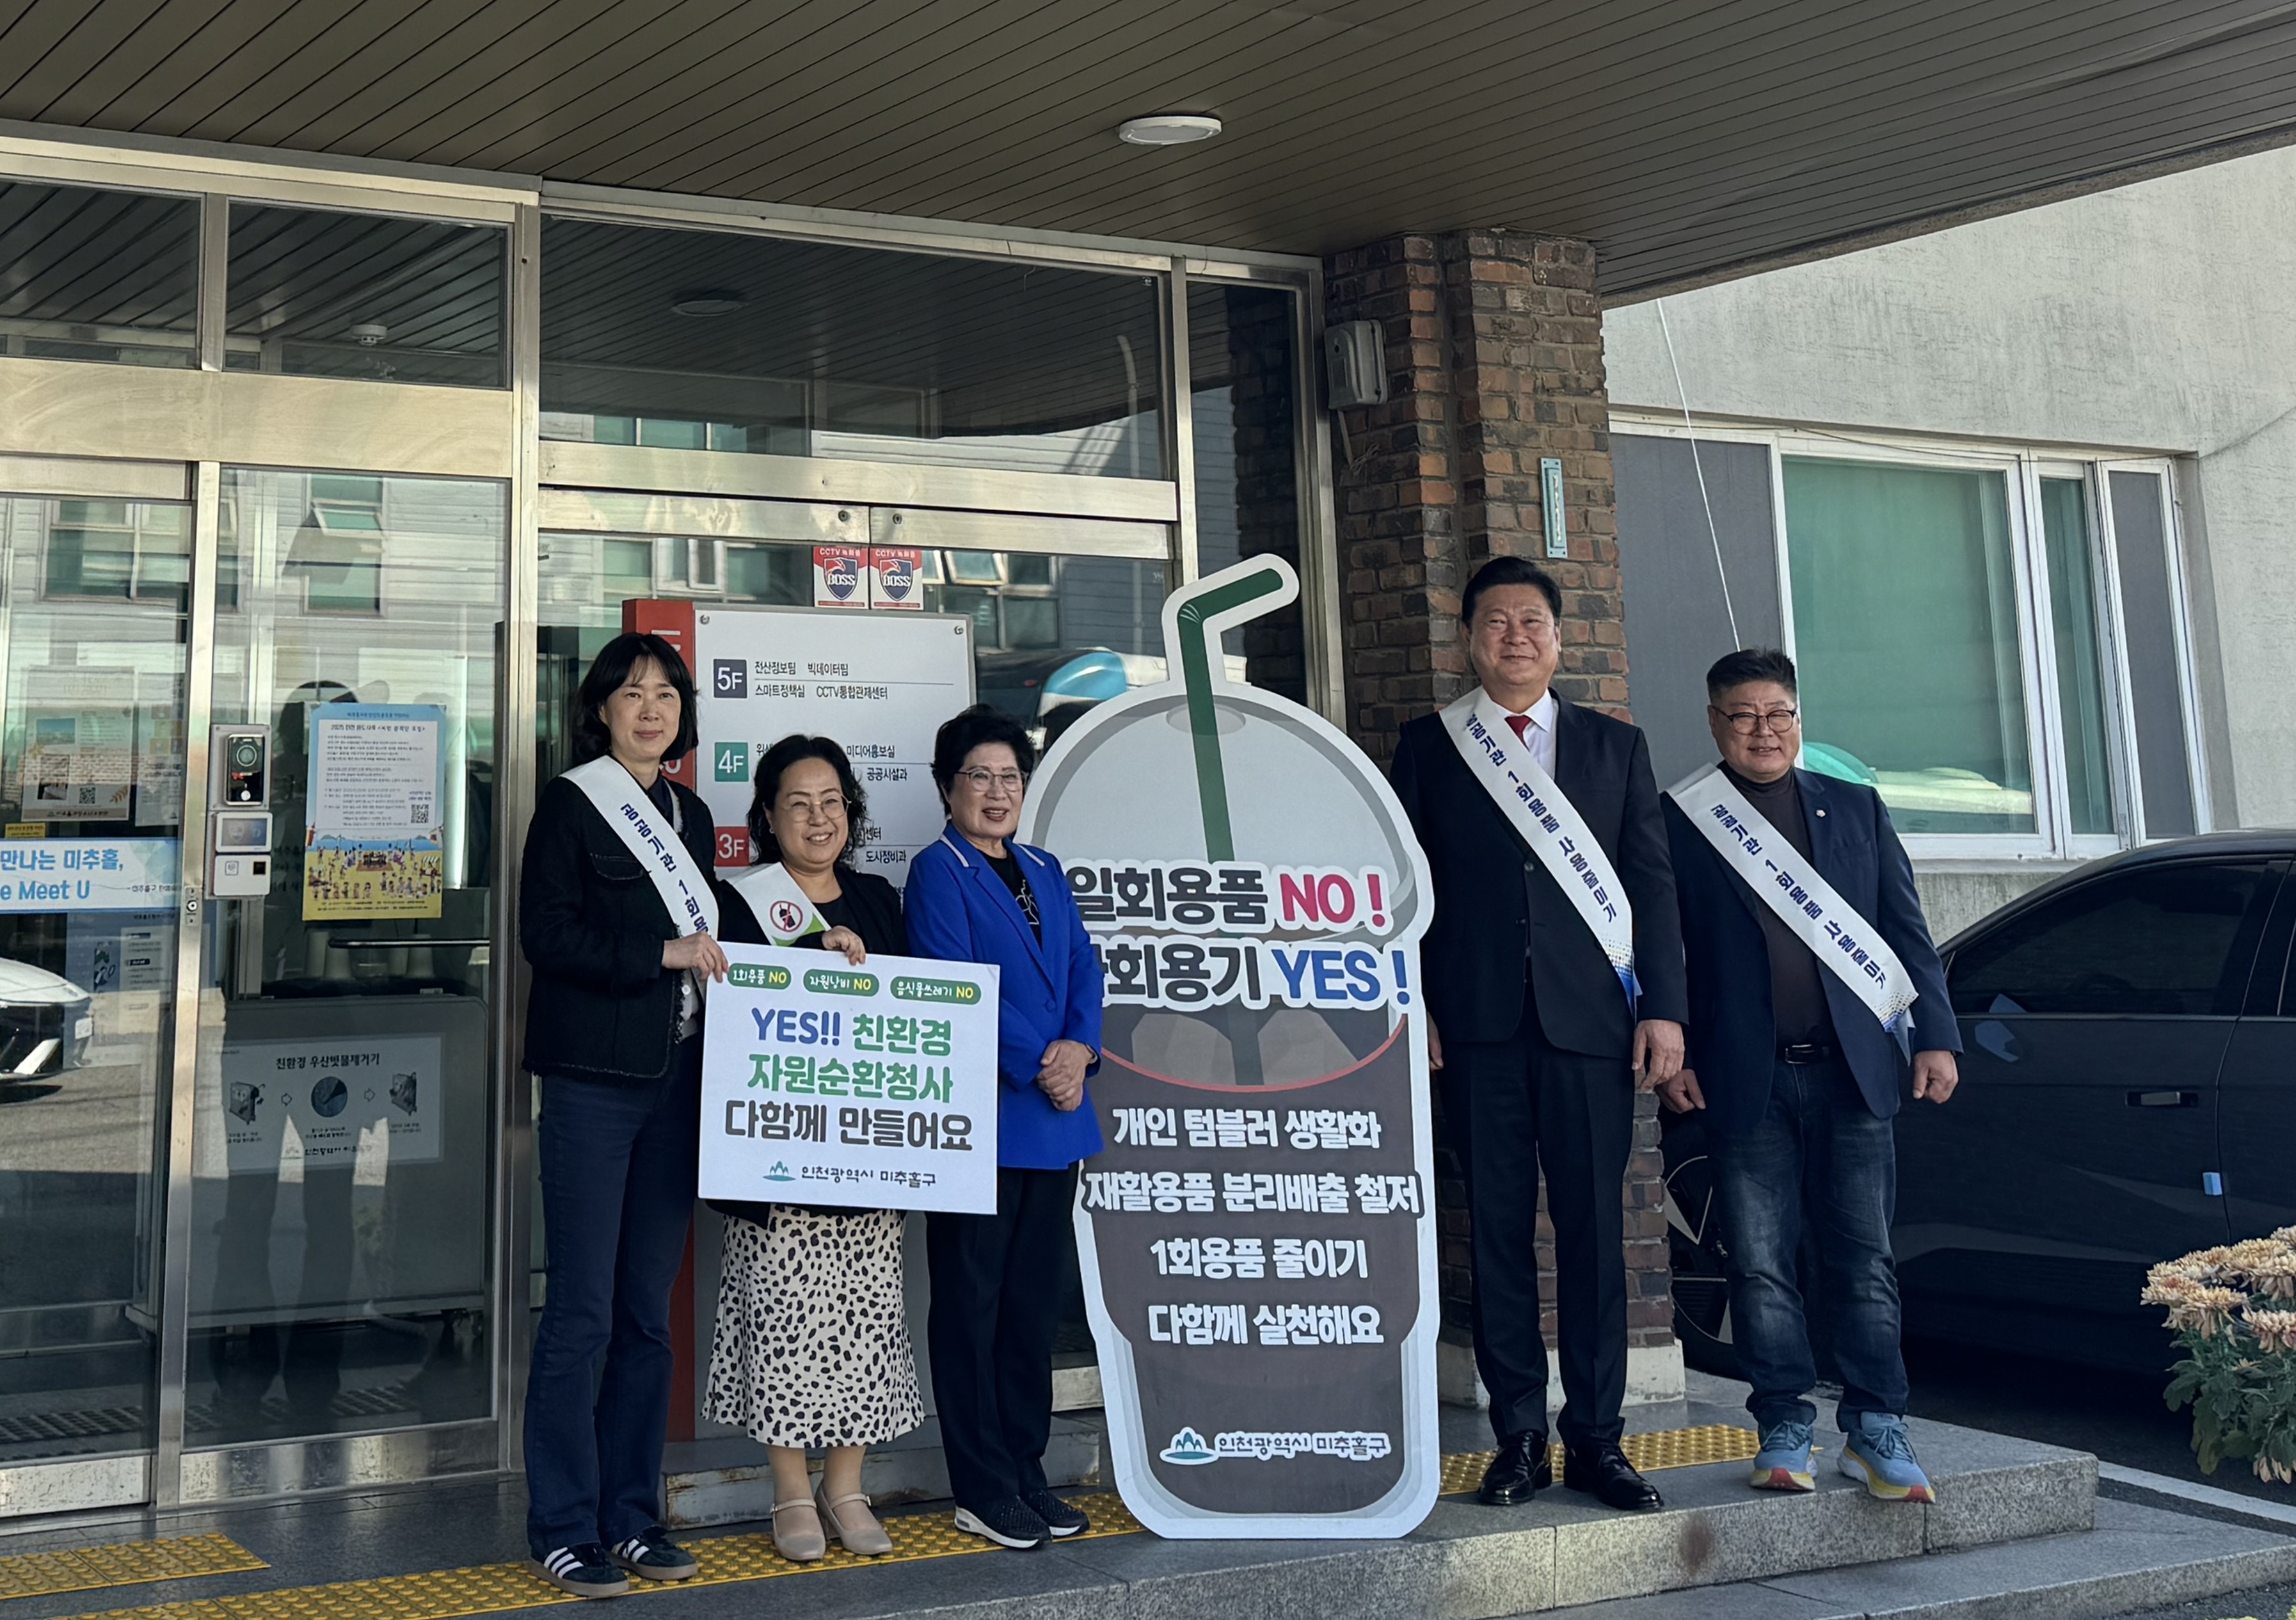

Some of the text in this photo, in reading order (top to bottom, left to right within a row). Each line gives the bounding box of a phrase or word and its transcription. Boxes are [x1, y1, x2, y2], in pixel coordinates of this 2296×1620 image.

[827, 573, 856, 586] BOSS
[884, 575, 911, 587] BOSS
[717, 667, 743, 691] 5F
[754, 661, 849, 676] 전산정보팀 빅데이터팀
[754, 684, 888, 700] 스마트정책실 CCTV통합관제센터
[718, 750, 744, 773] 4F
[847, 744, 895, 758] 미디어홍보실
[866, 767, 907, 782] 공공시설과
[719, 833, 745, 858] 3F
[866, 850, 906, 863] 도시정비과
[1507, 770, 1560, 834] 1회용품
[1559, 836, 1617, 923] 사용줄이기
[0, 849, 124, 871] 만나는 미추홀,
[620, 803, 677, 873] 공공기관
[678, 879, 709, 933] 1회용
[19, 879, 70, 900] Meet
[77, 880, 90, 899] U
[1065, 866, 1268, 924] 일회용품
[1710, 803, 1887, 990] 공공기관 1회용품 사용줄이기
[733, 968, 787, 985] 1회용품 NO
[809, 975, 872, 991] 자원낭비 NO
[897, 981, 973, 998] 음식물쓰레기 NO
[751, 1007, 952, 1057] YES!! 친환경
[276, 1057, 306, 1070] 친환경
[747, 1054, 953, 1103] 자원순환청사
[725, 1100, 973, 1151] 다함께 만들어요
[1112, 1108, 1382, 1149] 개인 텀블러 생활화
[802, 1166, 936, 1188] 인천광역시 미추홀구
[1085, 1171, 1419, 1214] 재활용품 분리배출 철저
[1150, 1237, 1369, 1279] 1회용품 줄이기
[1148, 1304, 1385, 1346] 다함께 실천해요
[1219, 1436, 1387, 1456] 인천광역시 미추홀구
